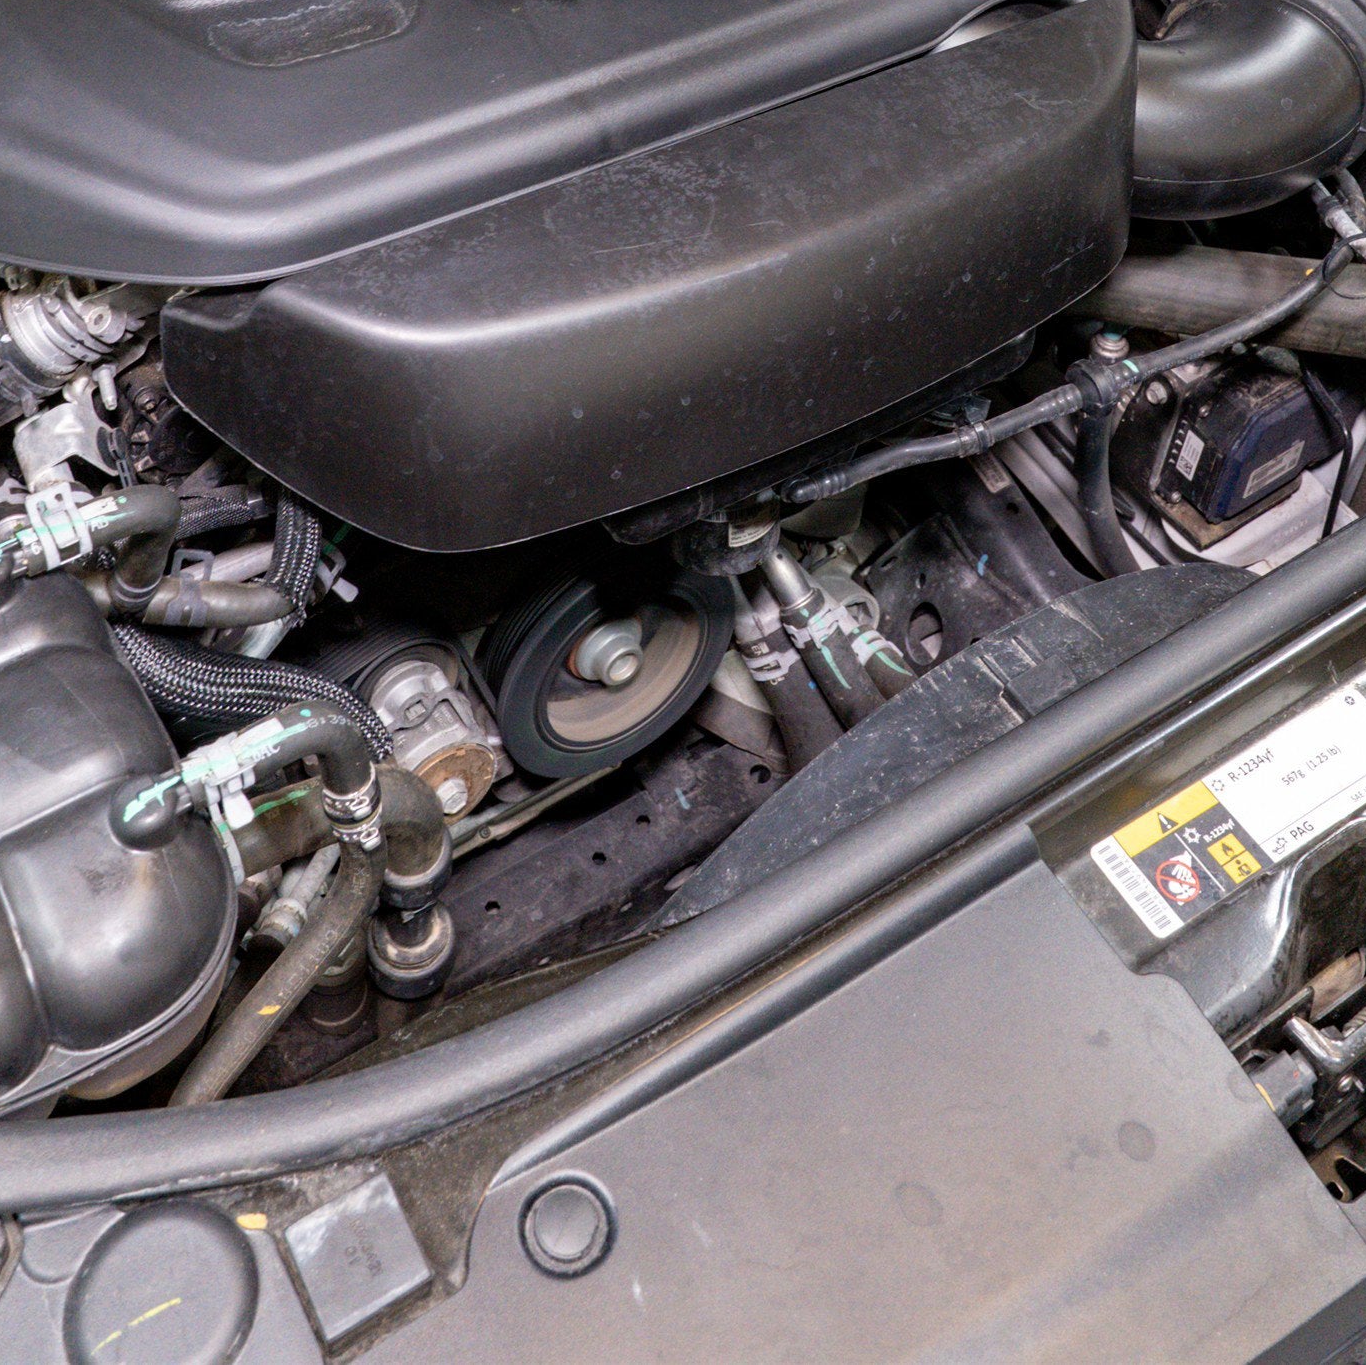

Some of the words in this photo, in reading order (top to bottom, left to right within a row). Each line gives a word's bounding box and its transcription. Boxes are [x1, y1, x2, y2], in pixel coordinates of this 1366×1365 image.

[1227, 748, 1275, 783] R-1234yf
[1281, 769, 1306, 786] 567g
[1289, 820, 1315, 840] PAG
